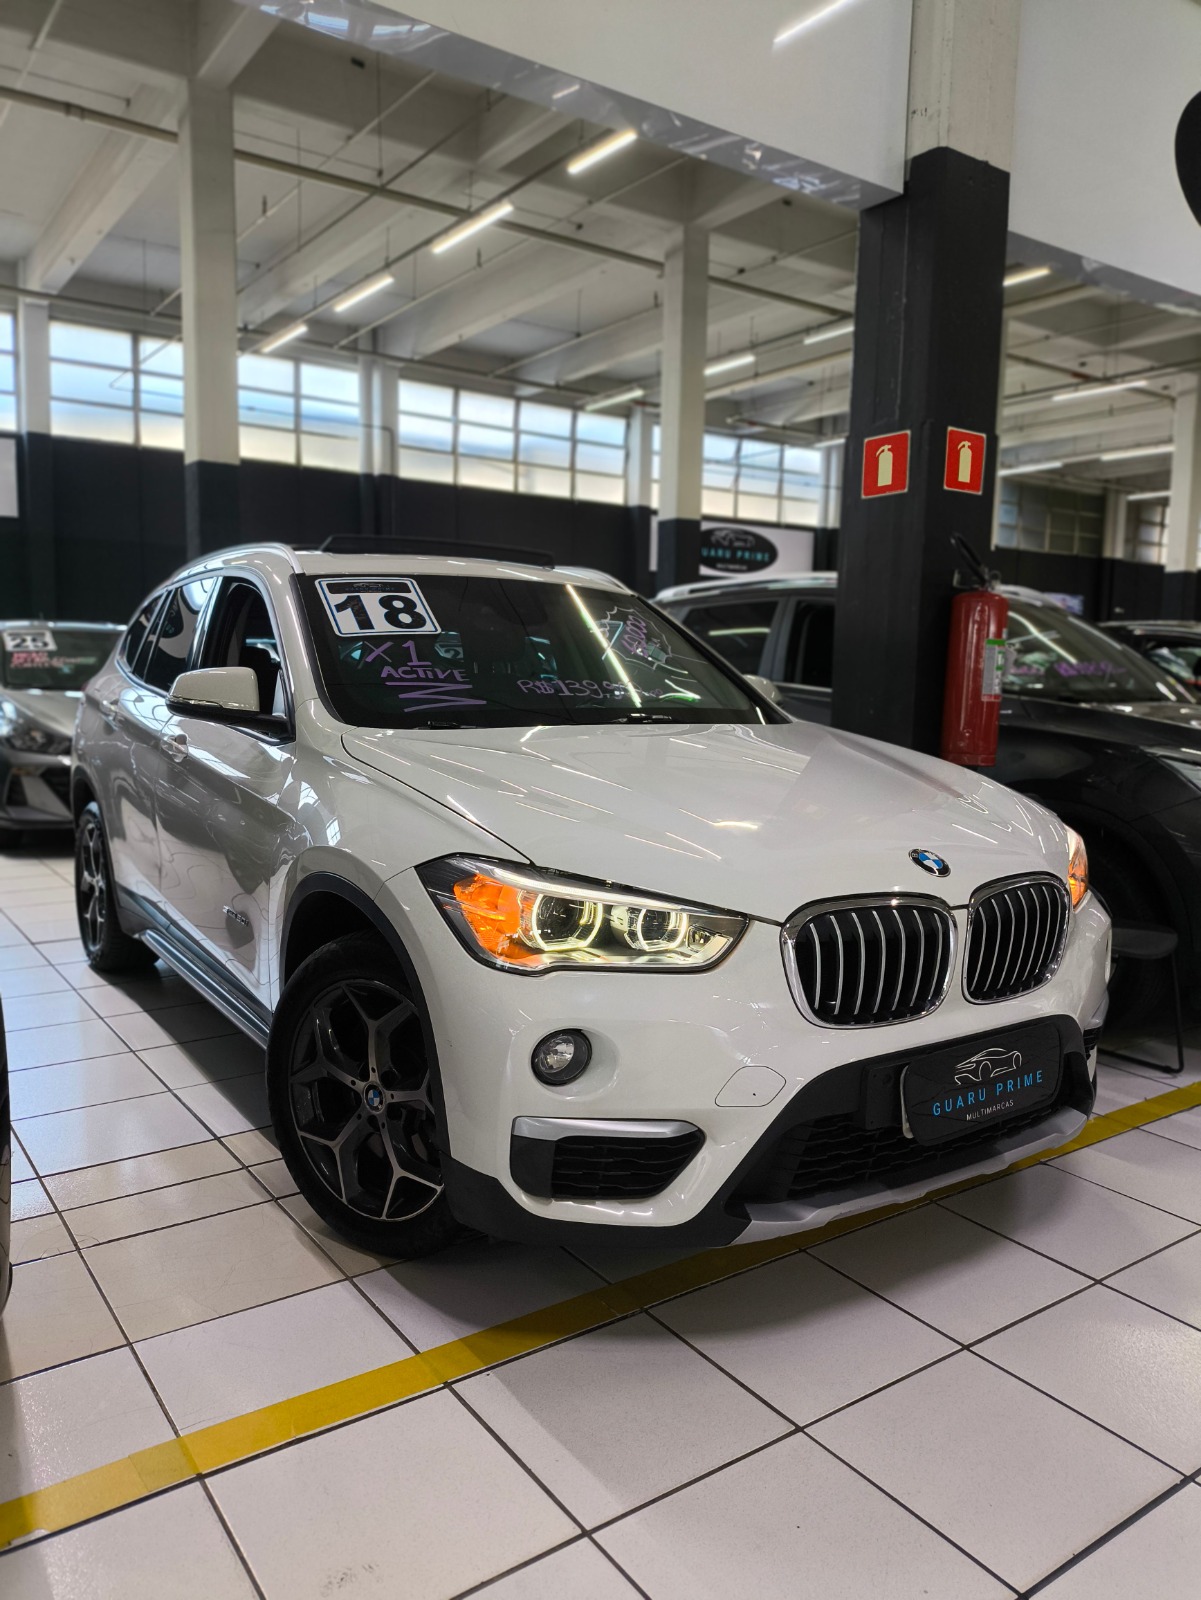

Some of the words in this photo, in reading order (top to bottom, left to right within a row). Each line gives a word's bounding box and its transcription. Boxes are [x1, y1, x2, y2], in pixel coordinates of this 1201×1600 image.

[333, 594, 427, 630] 18
[932, 1088, 986, 1116] GUARU
[996, 1070, 1043, 1096] PRIME
[966, 1099, 1014, 1121] MULTIMARCAS
